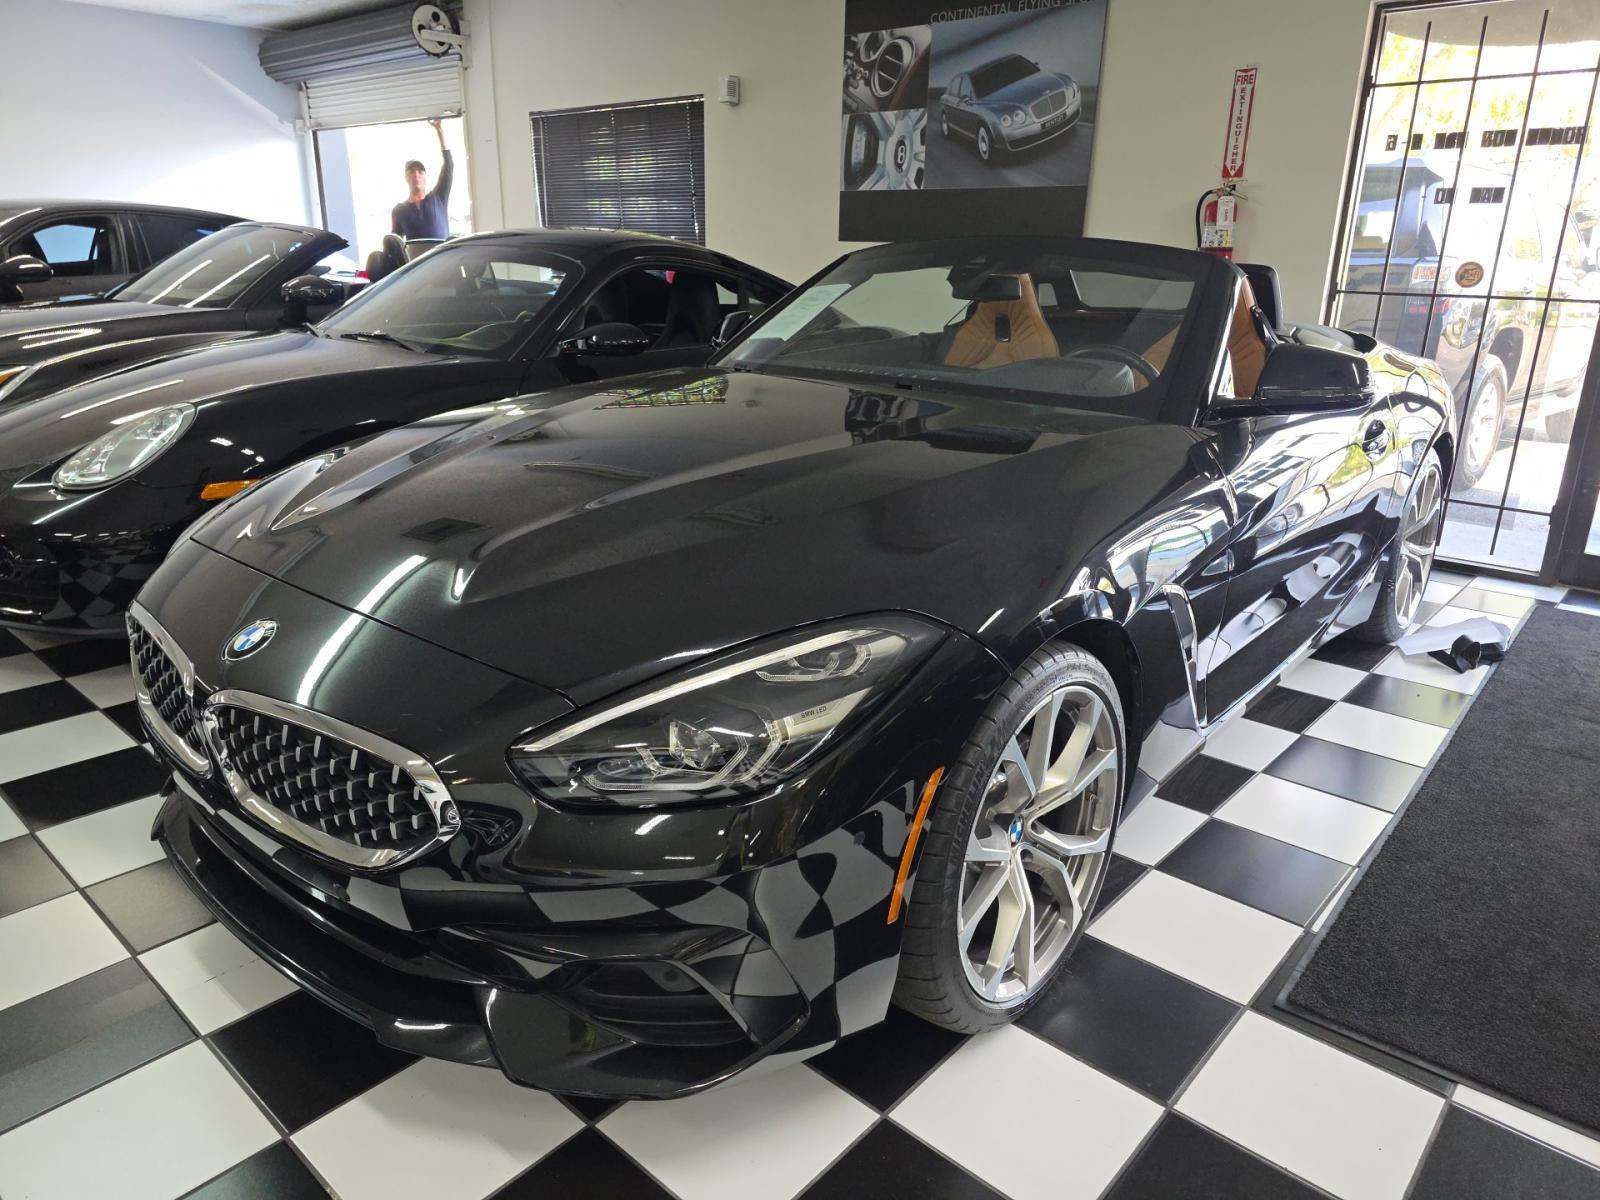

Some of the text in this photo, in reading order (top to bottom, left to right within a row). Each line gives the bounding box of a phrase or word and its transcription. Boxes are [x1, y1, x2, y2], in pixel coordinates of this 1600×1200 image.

[930, 0, 1061, 24] CONTINENTAL FLYING
[1236, 74, 1254, 86] FIRE
[1230, 87, 1246, 171] EXTINGUISHER
